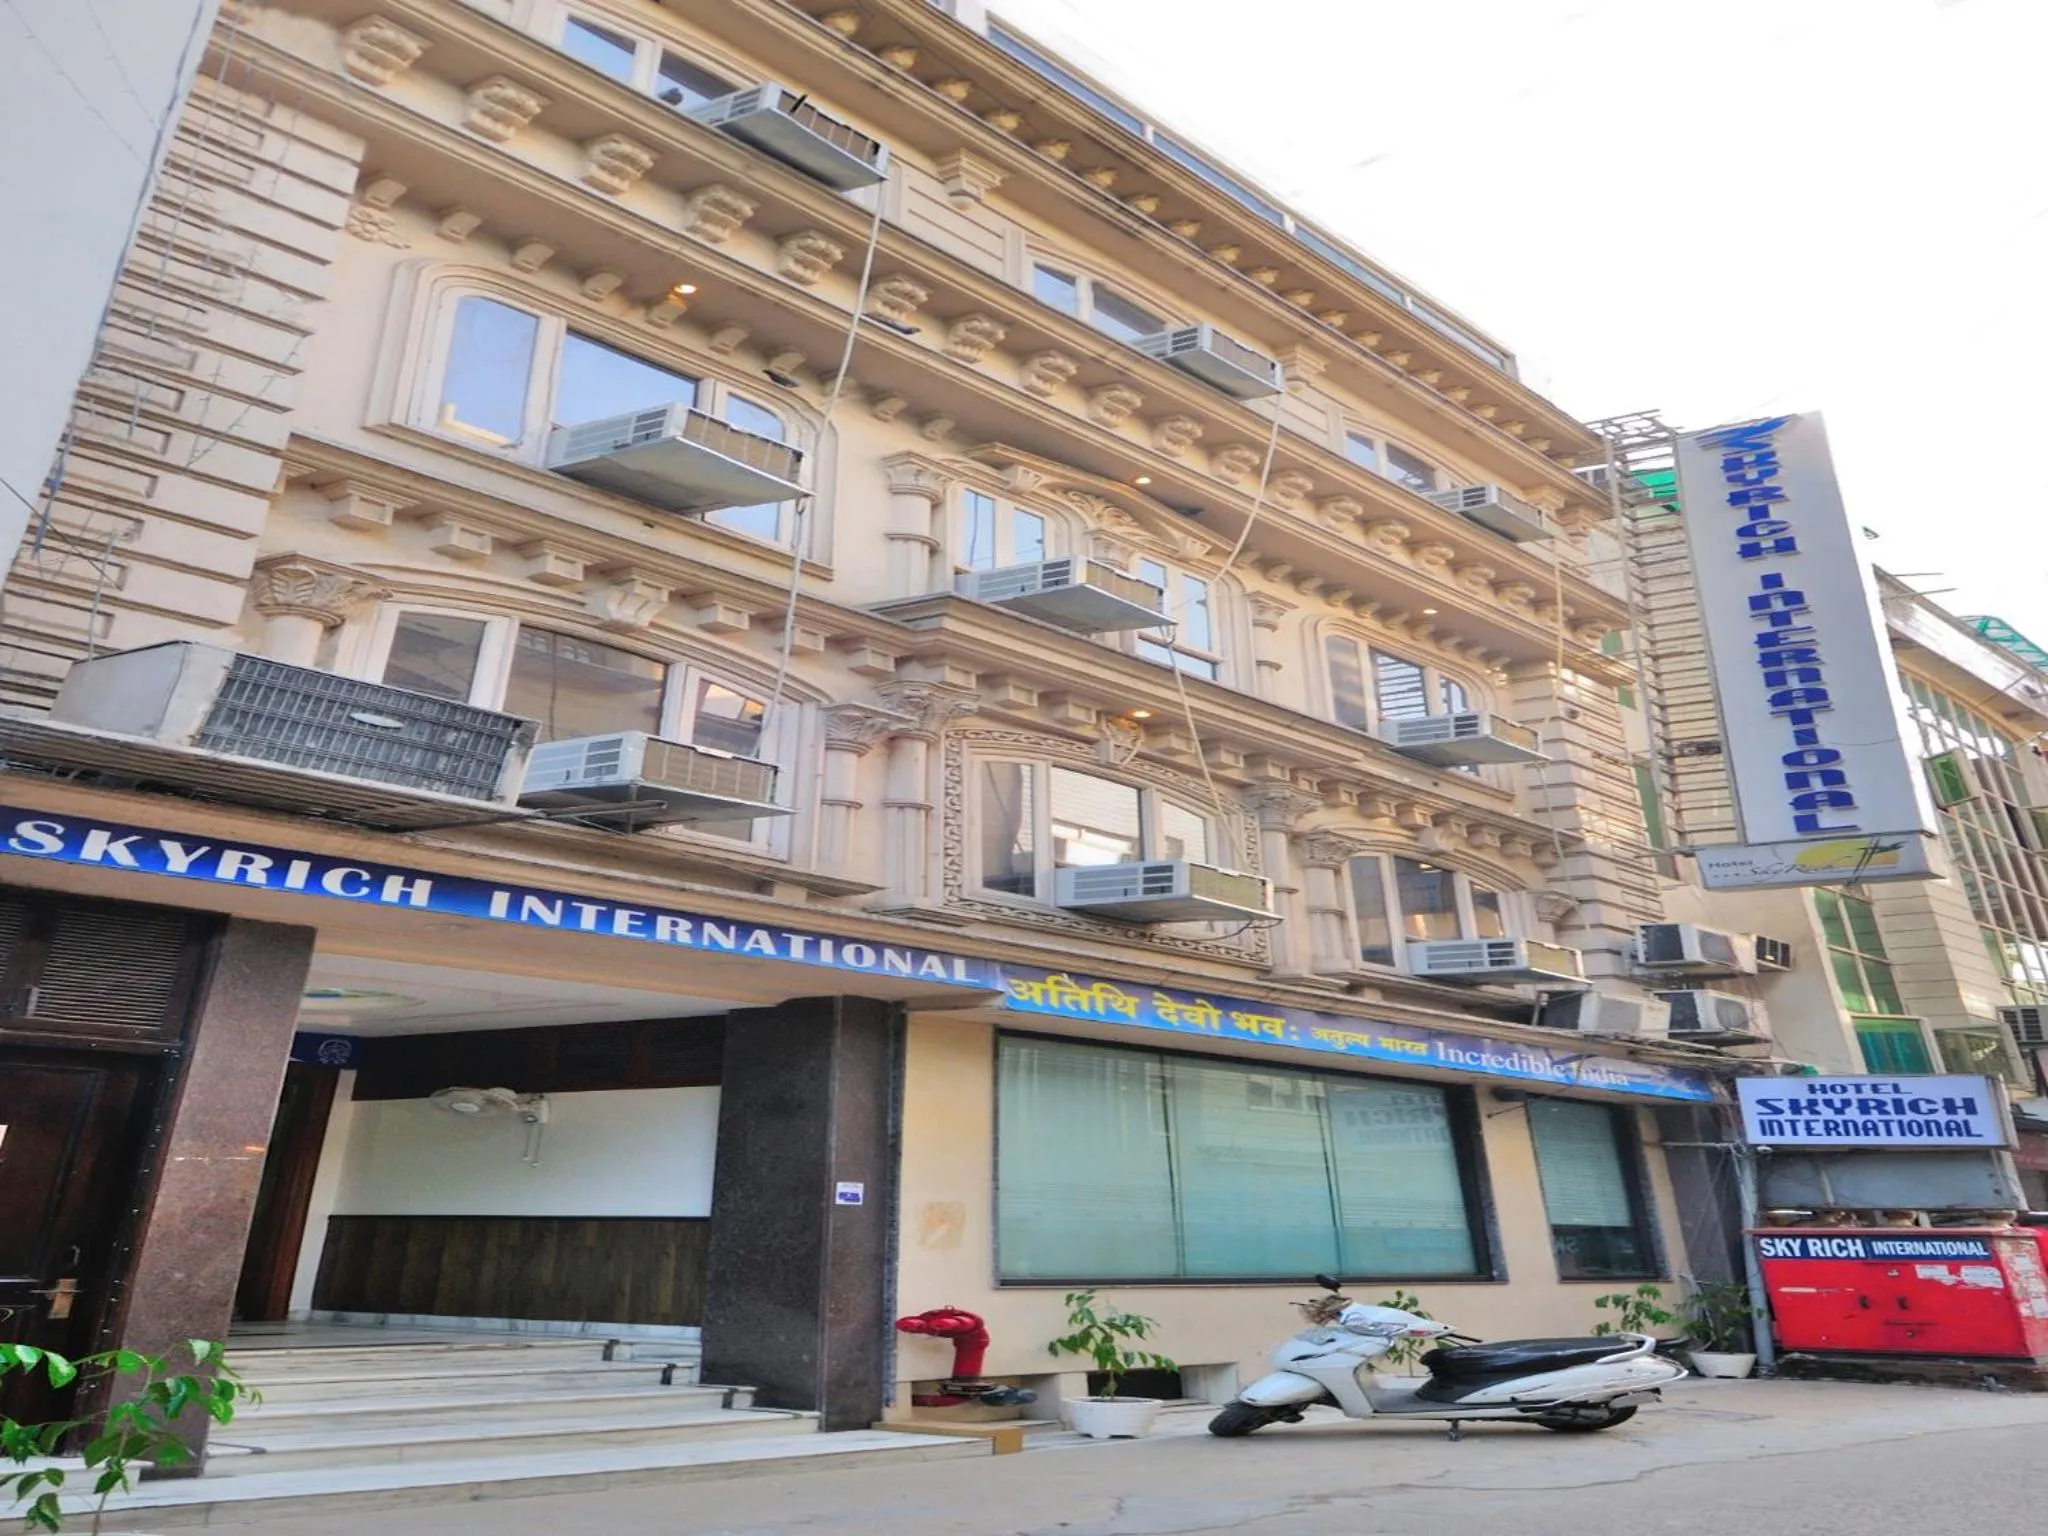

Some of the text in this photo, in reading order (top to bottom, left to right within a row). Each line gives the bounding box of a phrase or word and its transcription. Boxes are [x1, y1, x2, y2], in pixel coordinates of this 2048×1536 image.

[1748, 572, 1858, 833] INTERNATIONAL
[8, 820, 980, 982] SKYRICH INTERNATIONAL
[1152, 991, 1224, 1031] देवो
[1435, 1041, 1565, 1078] Incredible
[1807, 1083, 1913, 1095] HOTEL
[1756, 1097, 1978, 1116] SKYRICH
[1759, 1119, 1984, 1138] INTERNATIONAL
[1760, 1238, 1989, 1258] SKY RICH INTERNATIONAL
